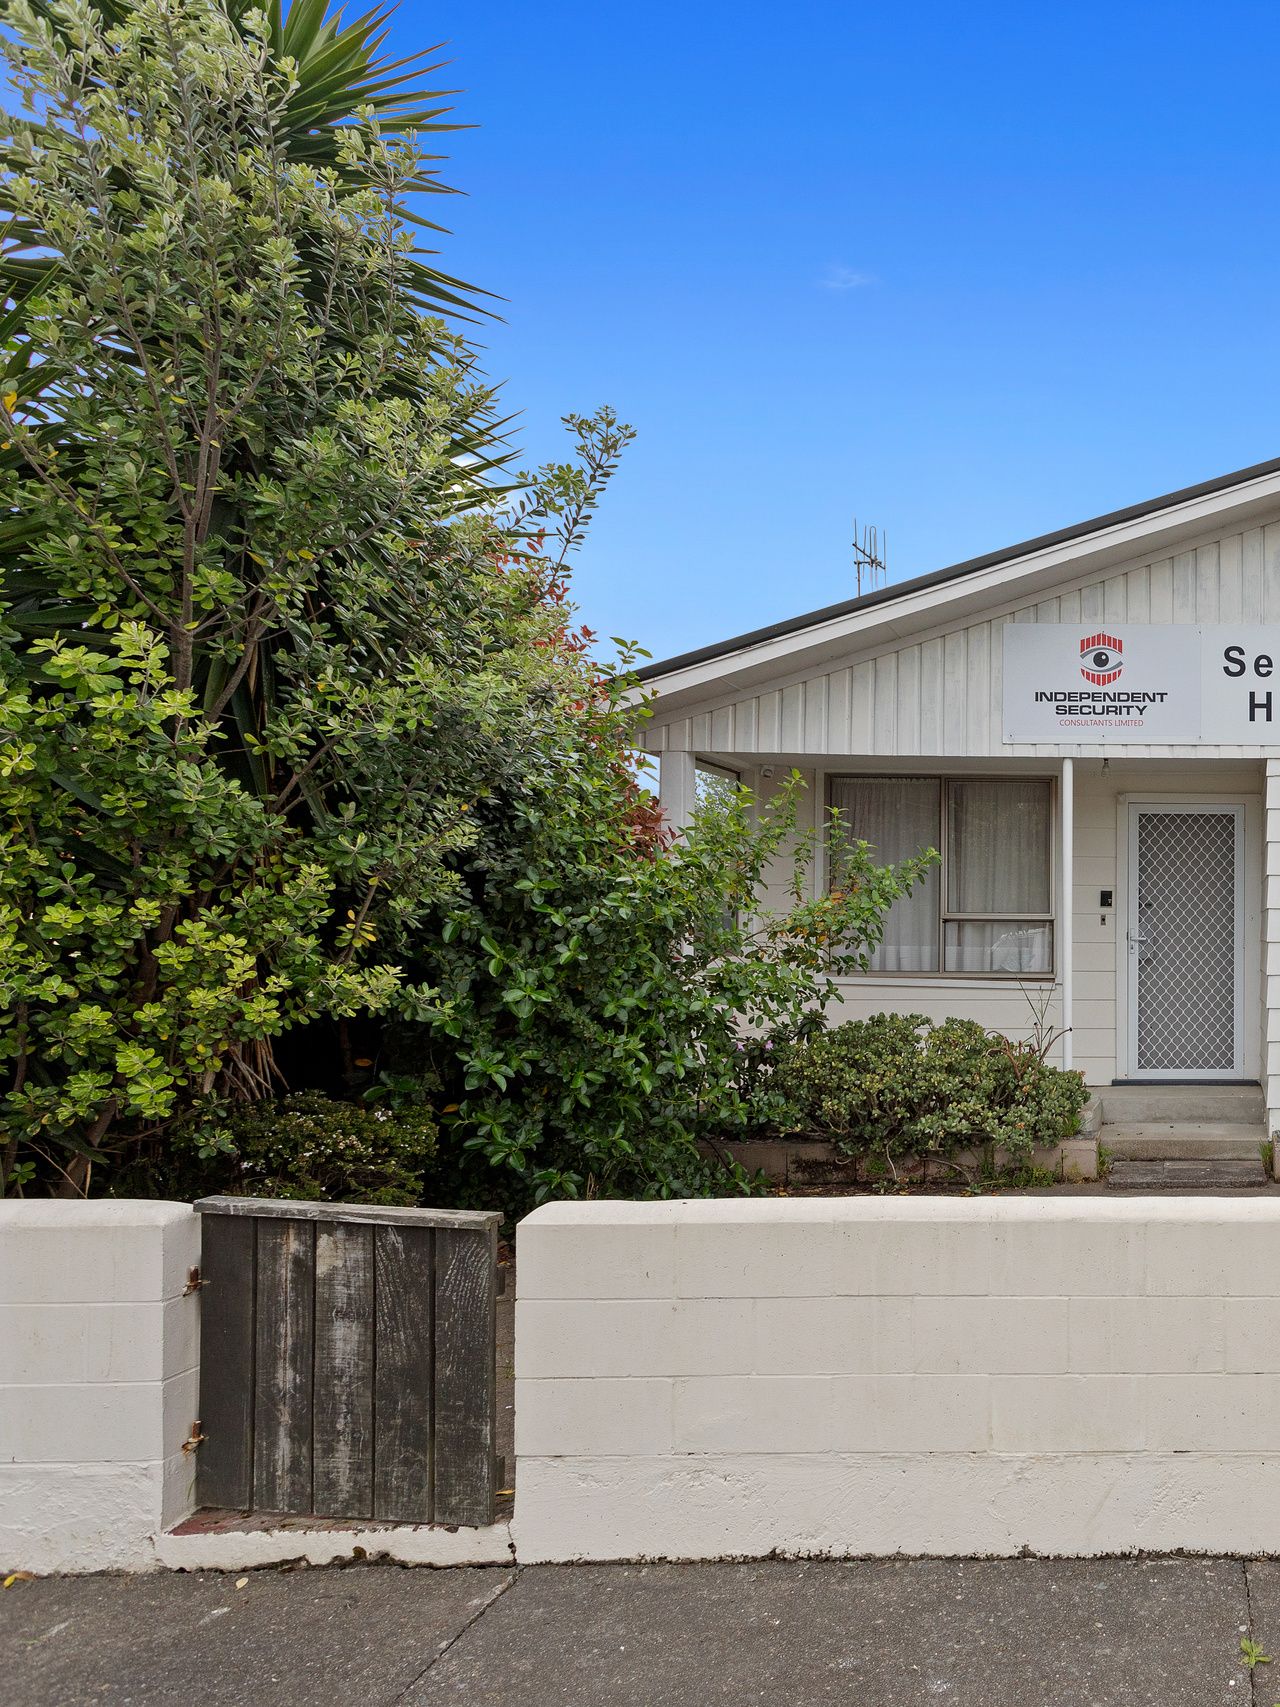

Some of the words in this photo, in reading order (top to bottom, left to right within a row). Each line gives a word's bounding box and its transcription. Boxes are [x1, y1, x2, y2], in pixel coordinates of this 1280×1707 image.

[1034, 691, 1168, 703] INDEPENDENT
[1055, 705, 1148, 716] SECURITY
[1059, 719, 1113, 727] CONSULTANTS
[1114, 719, 1144, 727] LIMITED
